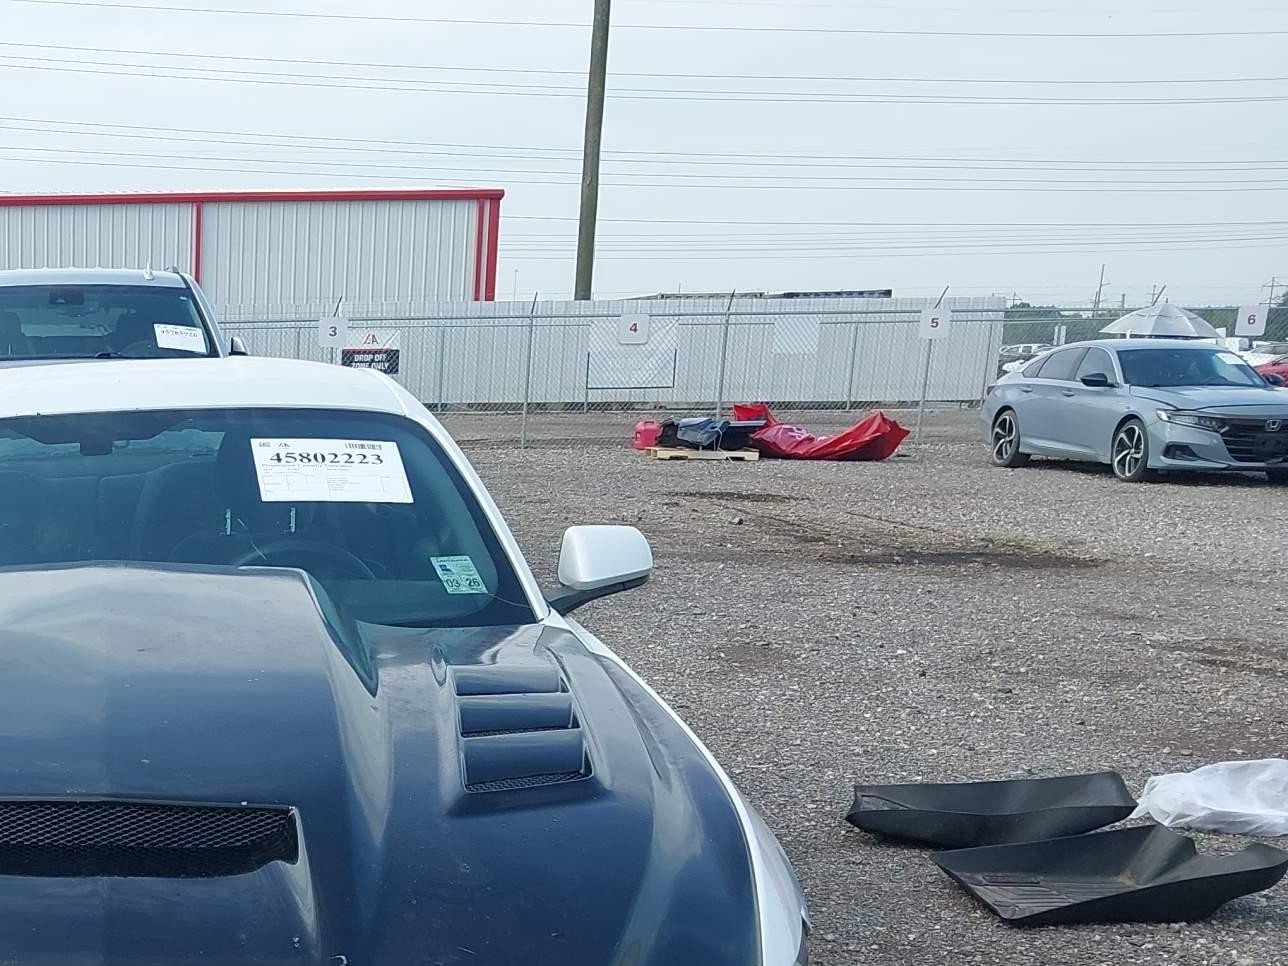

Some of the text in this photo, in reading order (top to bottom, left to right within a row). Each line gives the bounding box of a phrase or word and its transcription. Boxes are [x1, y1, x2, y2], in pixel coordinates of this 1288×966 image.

[930, 317, 940, 328] 5
[1247, 314, 1256, 325] 6
[328, 326, 338, 337] 3
[629, 322, 638, 333] 4
[374, 353, 388, 361] OFF
[371, 361, 389, 370] ONLY
[269, 452, 384, 465] 45802223
[445, 577, 481, 588] 03 26
